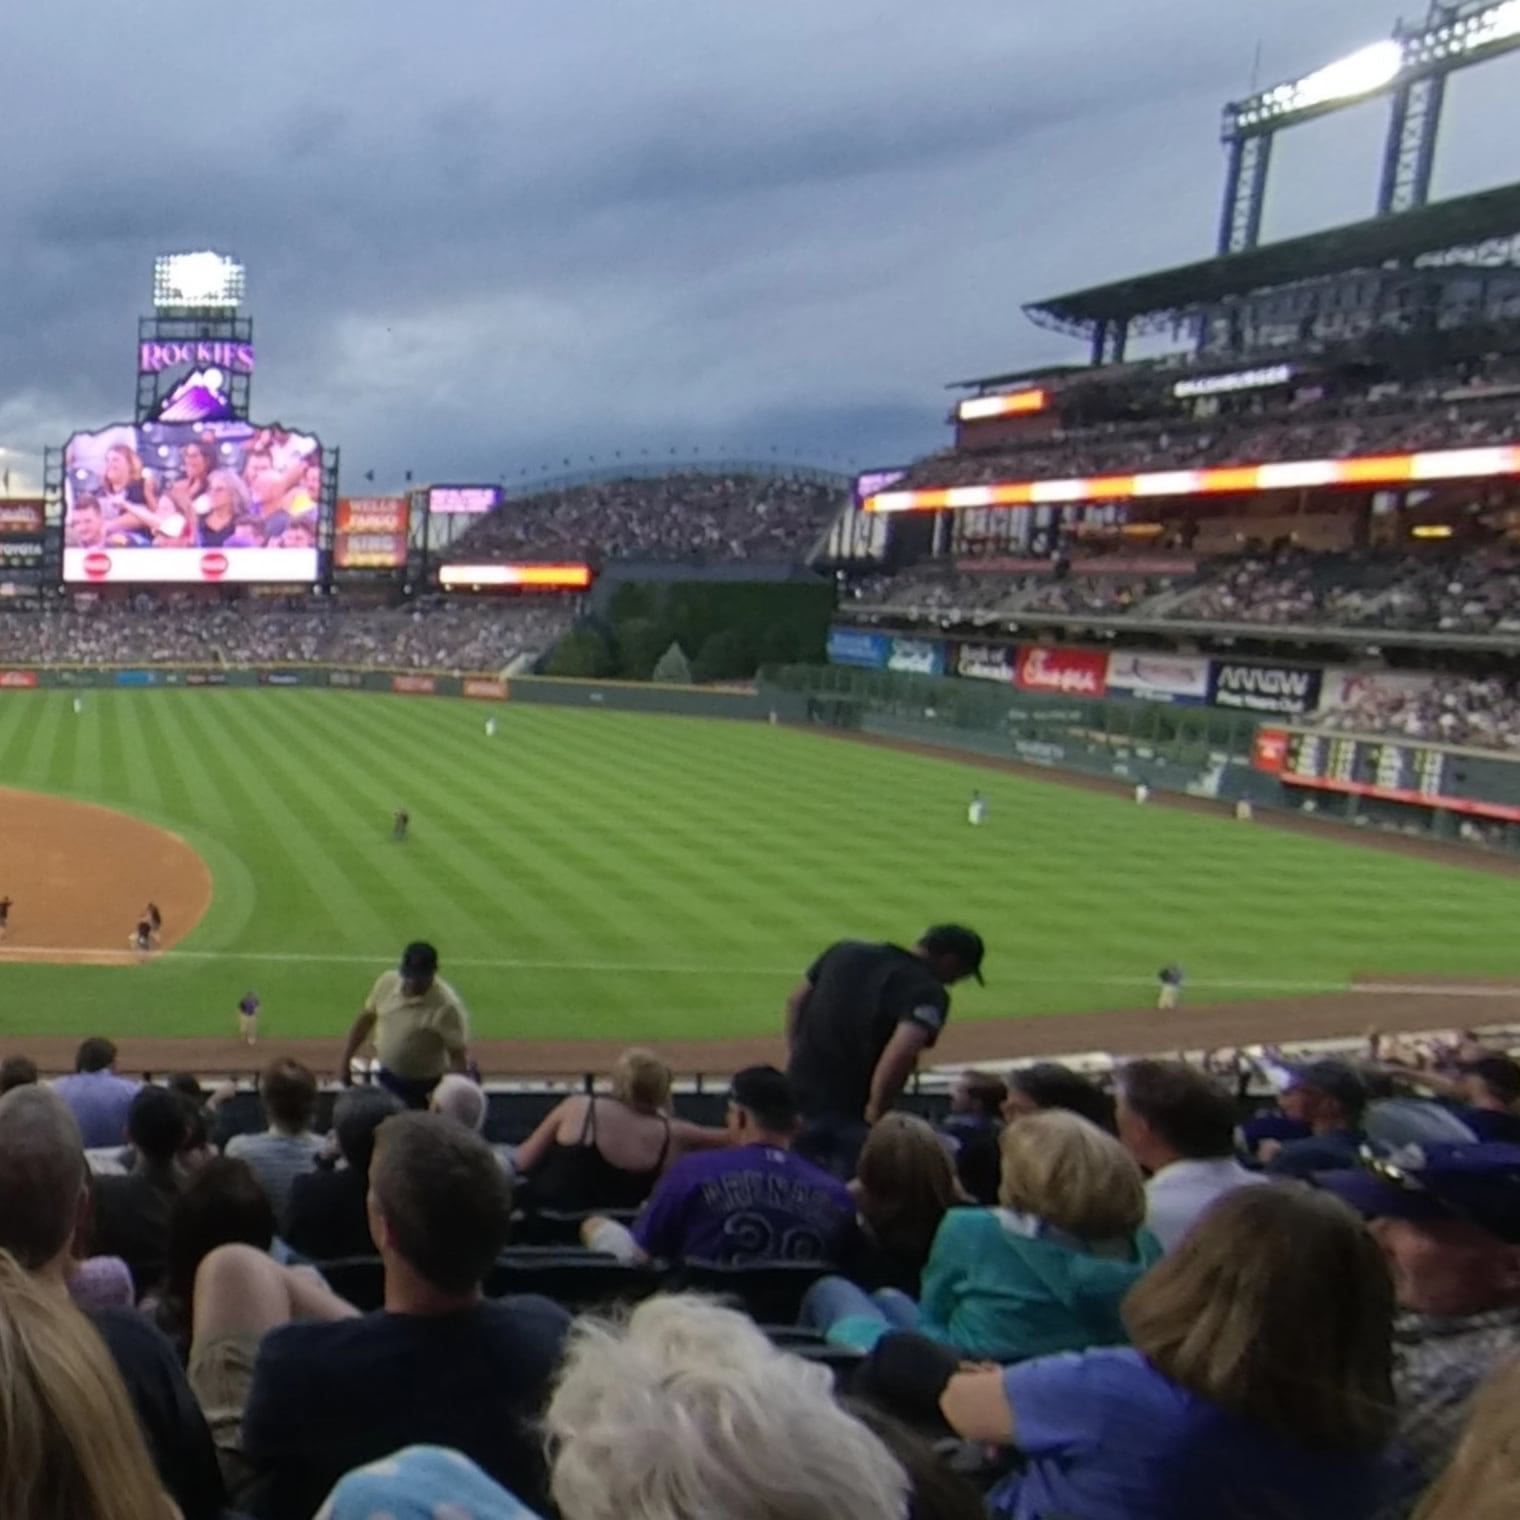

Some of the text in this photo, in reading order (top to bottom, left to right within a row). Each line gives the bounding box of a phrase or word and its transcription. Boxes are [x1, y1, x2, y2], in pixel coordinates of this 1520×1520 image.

[141, 342, 254, 371] ROCKIES
[349, 501, 398, 512] WELLS
[348, 514, 398, 529] FARGO
[1216, 665, 1309, 697] ARROW
